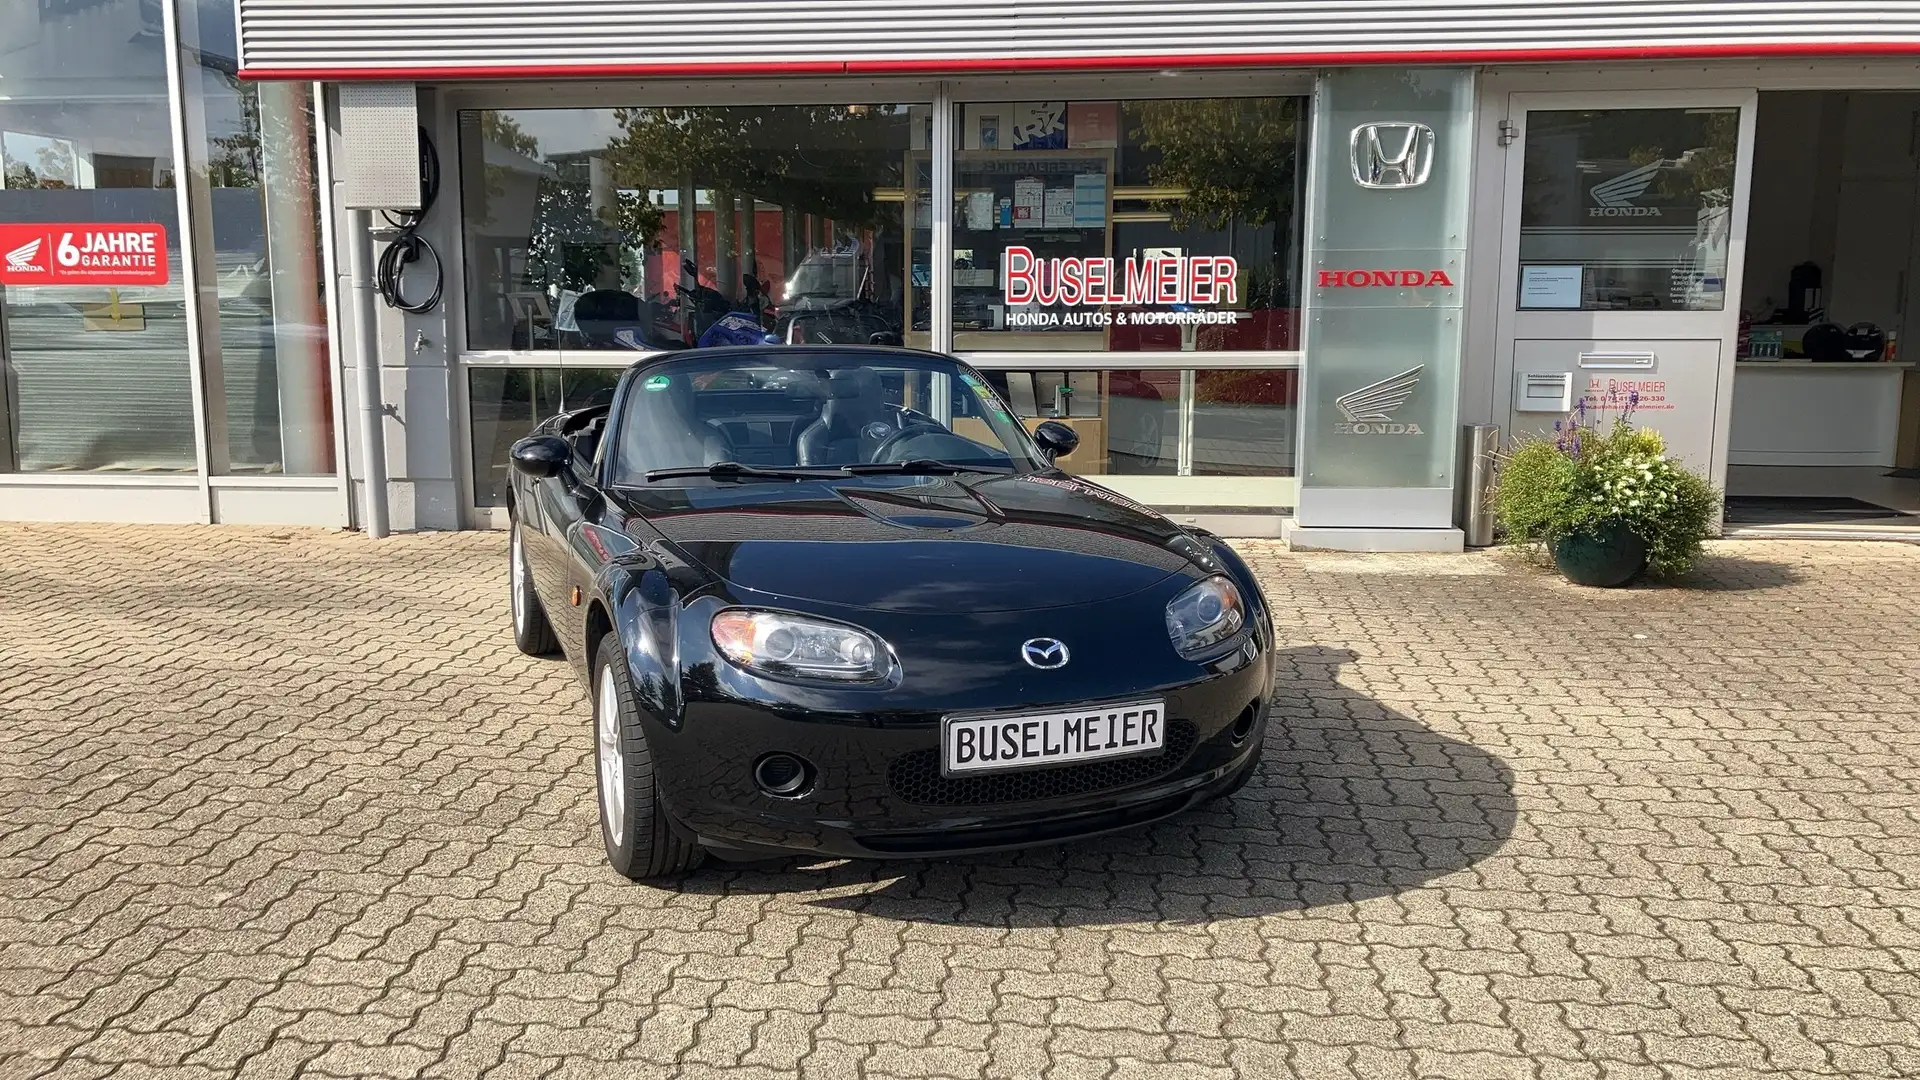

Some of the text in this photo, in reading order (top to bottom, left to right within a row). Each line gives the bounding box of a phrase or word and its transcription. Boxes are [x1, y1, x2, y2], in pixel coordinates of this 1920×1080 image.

[1588, 207, 1662, 217] HONDA
[57, 232, 80, 267] 6
[81, 254, 156, 267] GARANTIE
[6, 265, 46, 273] HONDA
[1317, 271, 1454, 288] HONDA
[1005, 309, 1237, 326] HONDA AUTOS & MOTORRÄDER
[1334, 422, 1424, 435] HONDA
[956, 709, 1158, 764] BUSELMEIER
